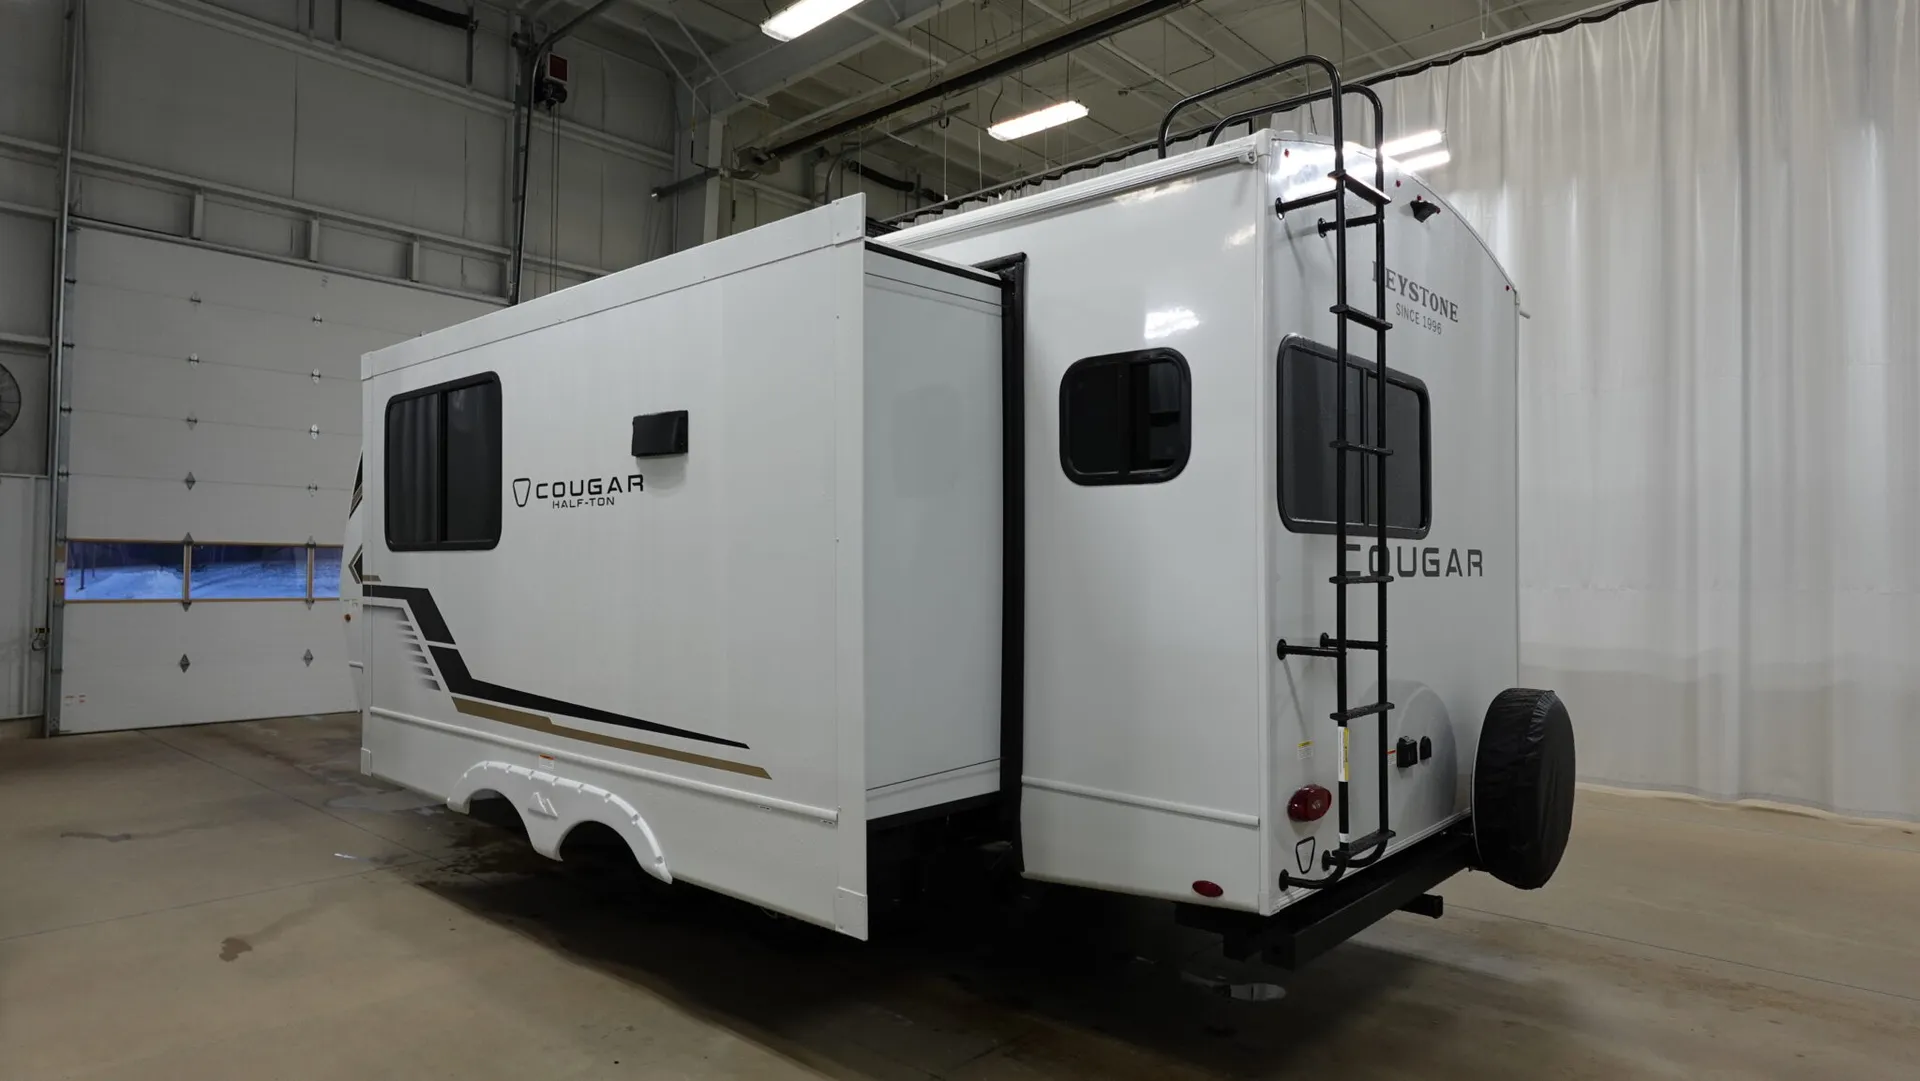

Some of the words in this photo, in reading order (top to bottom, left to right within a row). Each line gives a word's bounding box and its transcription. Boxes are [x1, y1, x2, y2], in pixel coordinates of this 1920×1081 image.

[1395, 302, 1420, 325] SINCE
[535, 474, 644, 499] COUGAR
[552, 496, 615, 509] HALF-TON
